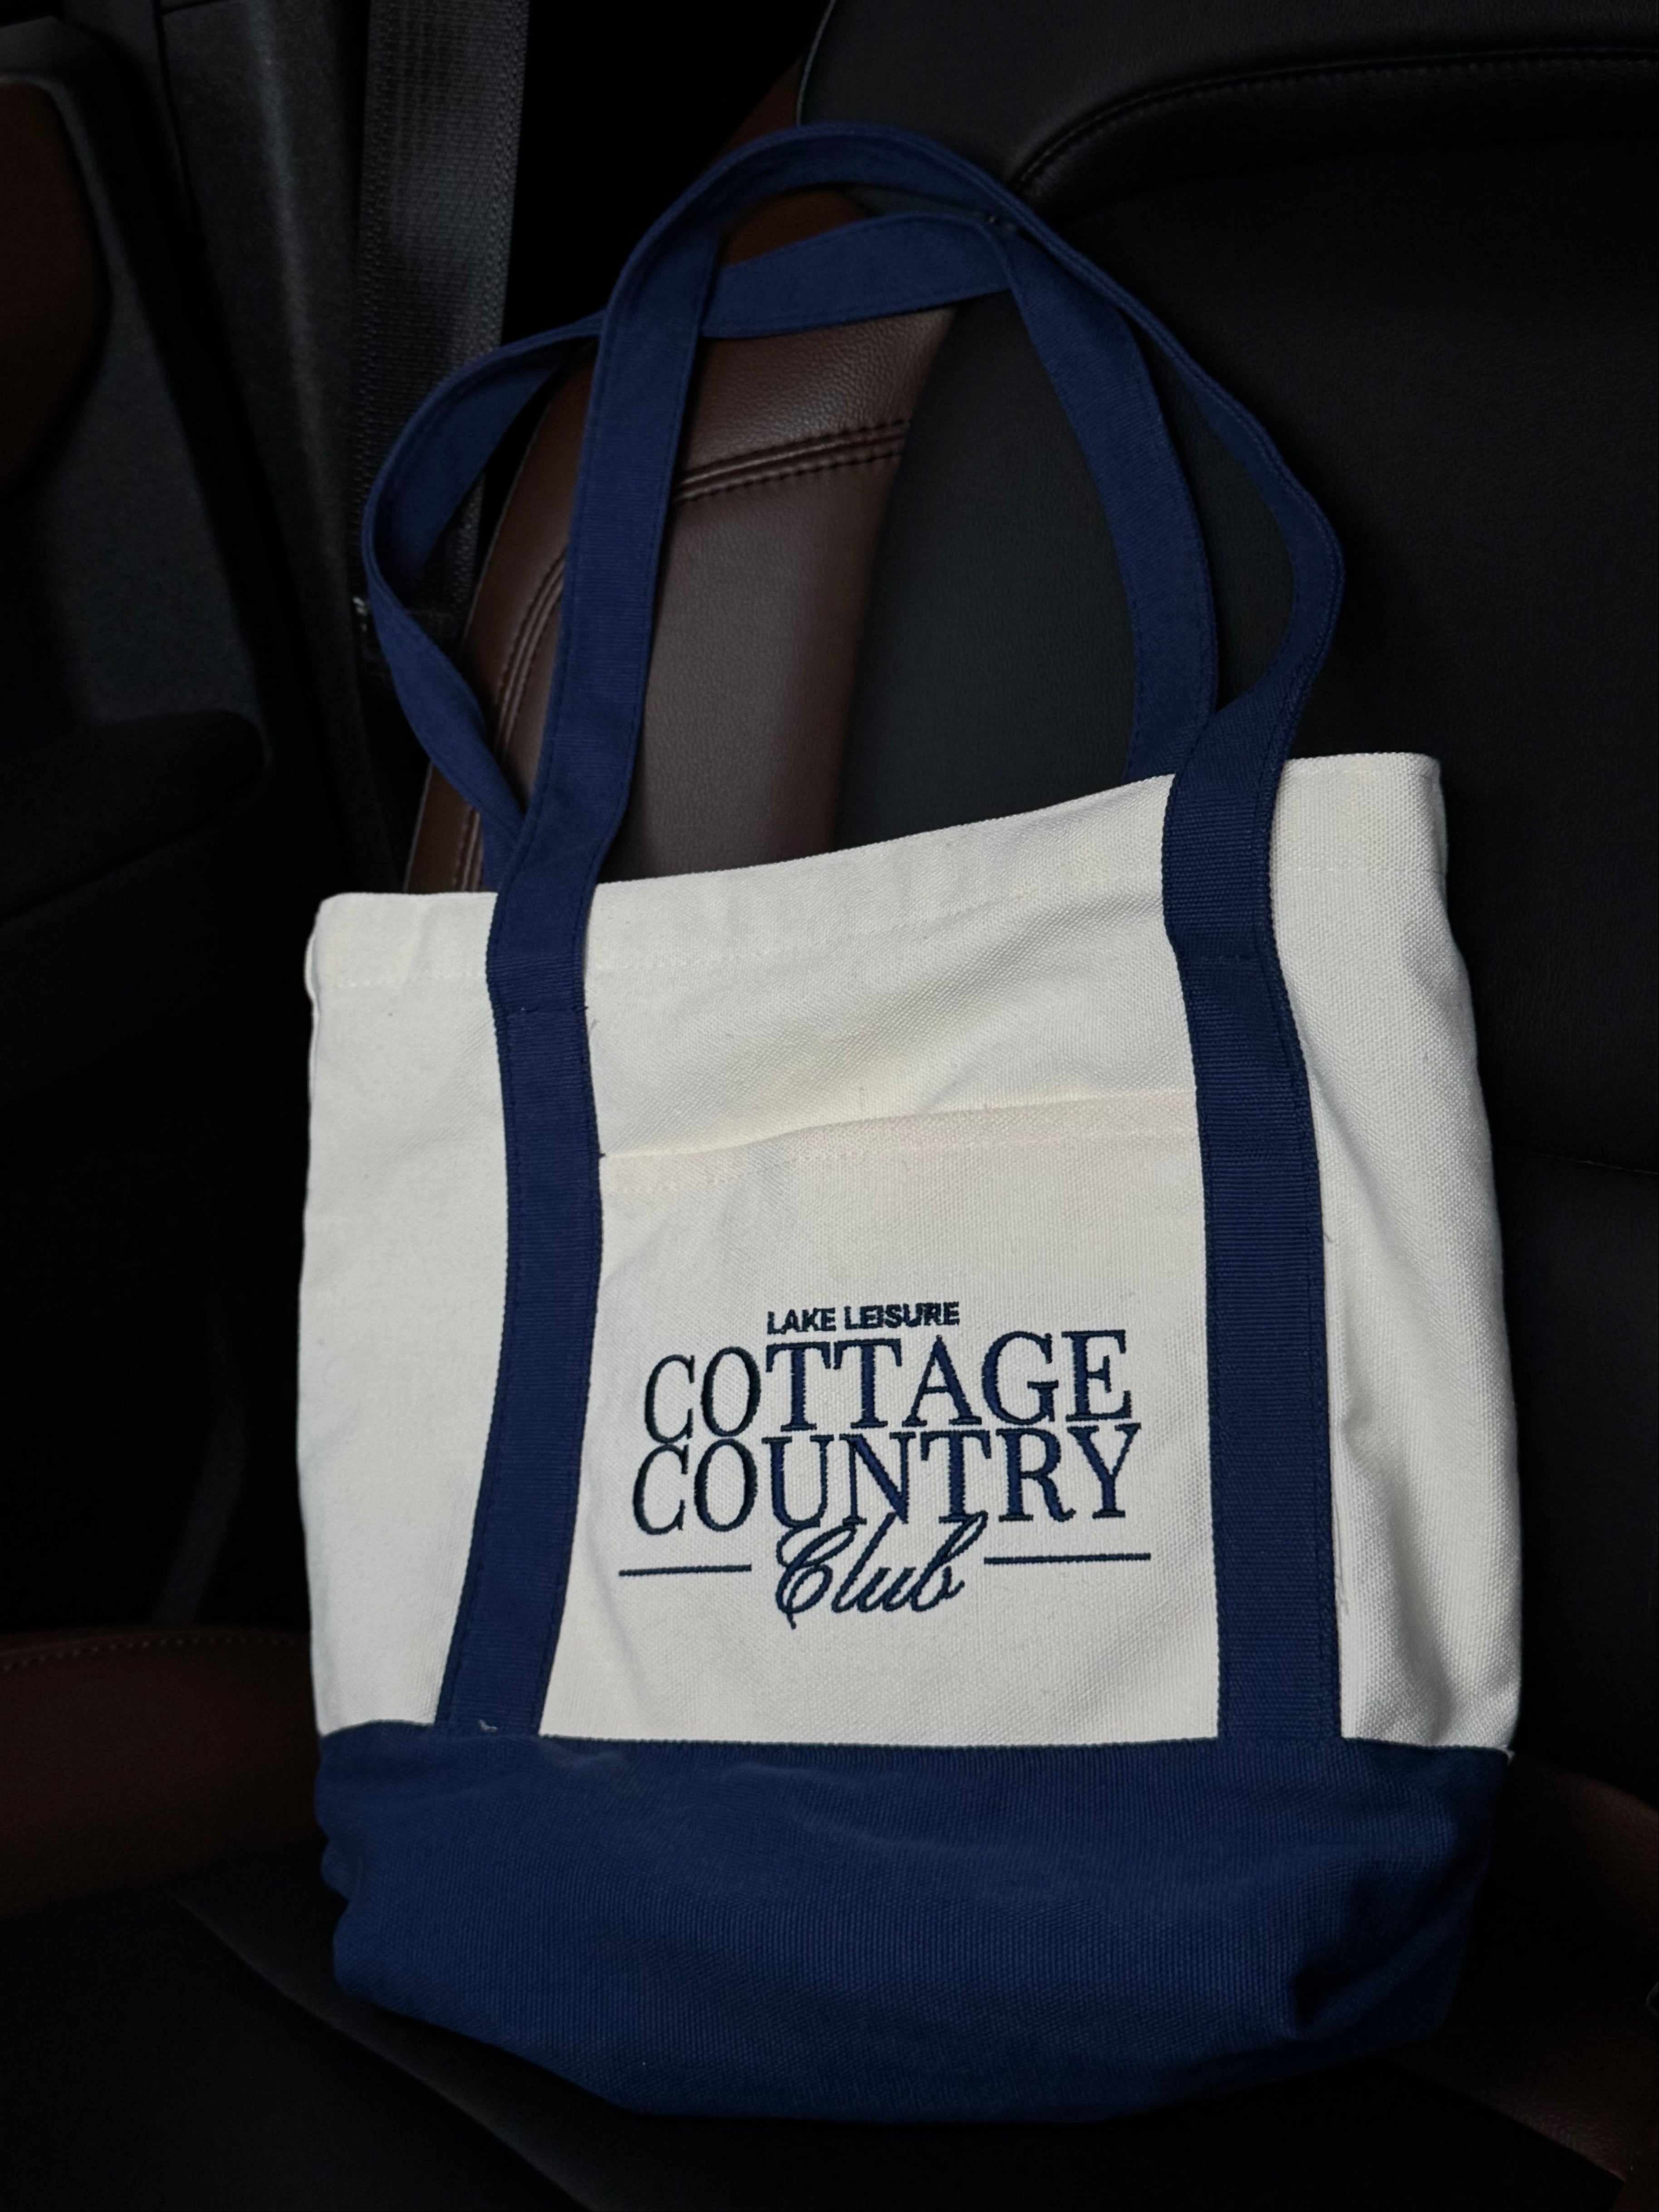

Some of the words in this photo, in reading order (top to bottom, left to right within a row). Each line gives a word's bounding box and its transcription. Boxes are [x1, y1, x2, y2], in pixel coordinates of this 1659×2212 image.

[766, 1307, 837, 1335] LAKE
[844, 1301, 961, 1330] LEISURE
[643, 1329, 1133, 1444] COTTAGE
[632, 1422, 1142, 1535] COUNTRY
[775, 1510, 989, 1630] Club
